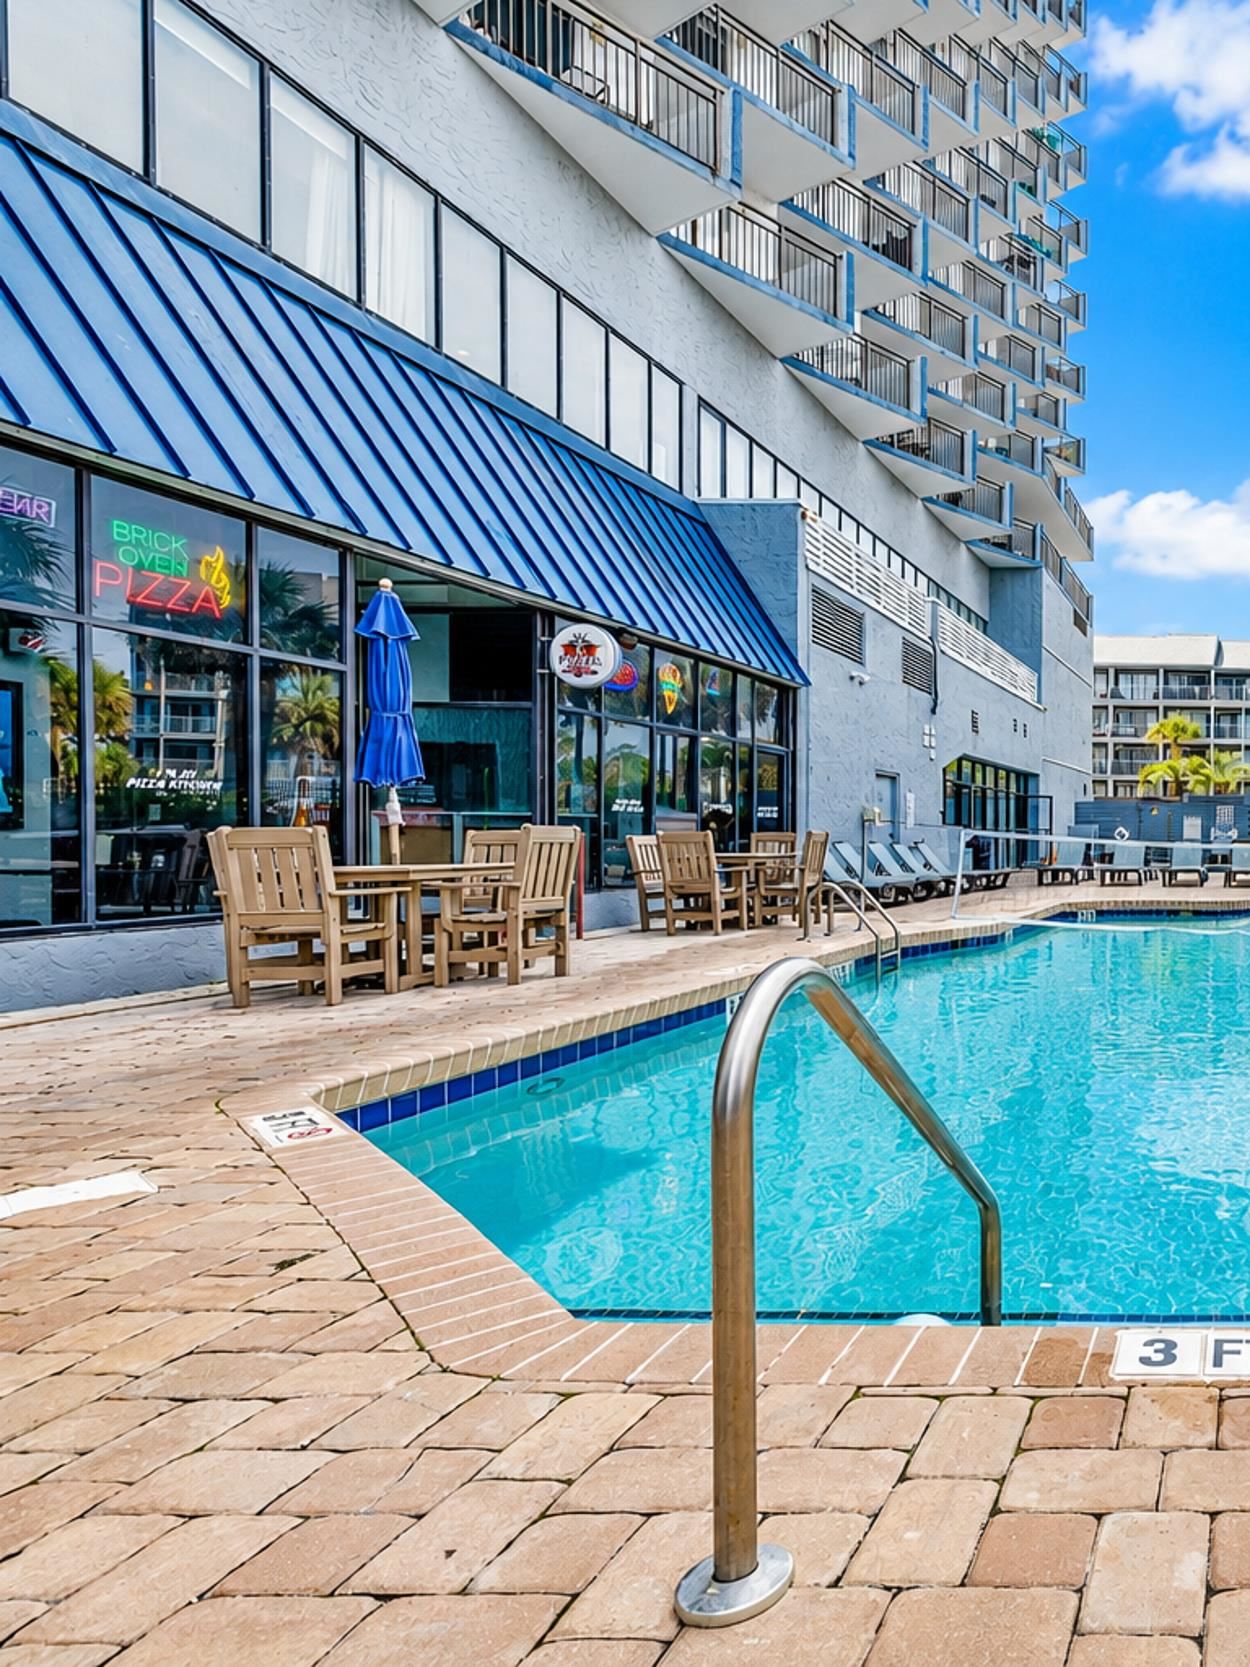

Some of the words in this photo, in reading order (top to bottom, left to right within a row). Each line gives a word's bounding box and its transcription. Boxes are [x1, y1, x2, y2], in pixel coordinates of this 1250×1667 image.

[113, 520, 190, 560] BRICK
[119, 545, 188, 577] OVEN
[94, 561, 222, 619] PIZZA
[126, 777, 166, 789] PIZZA
[1138, 1338, 1179, 1367] 3
